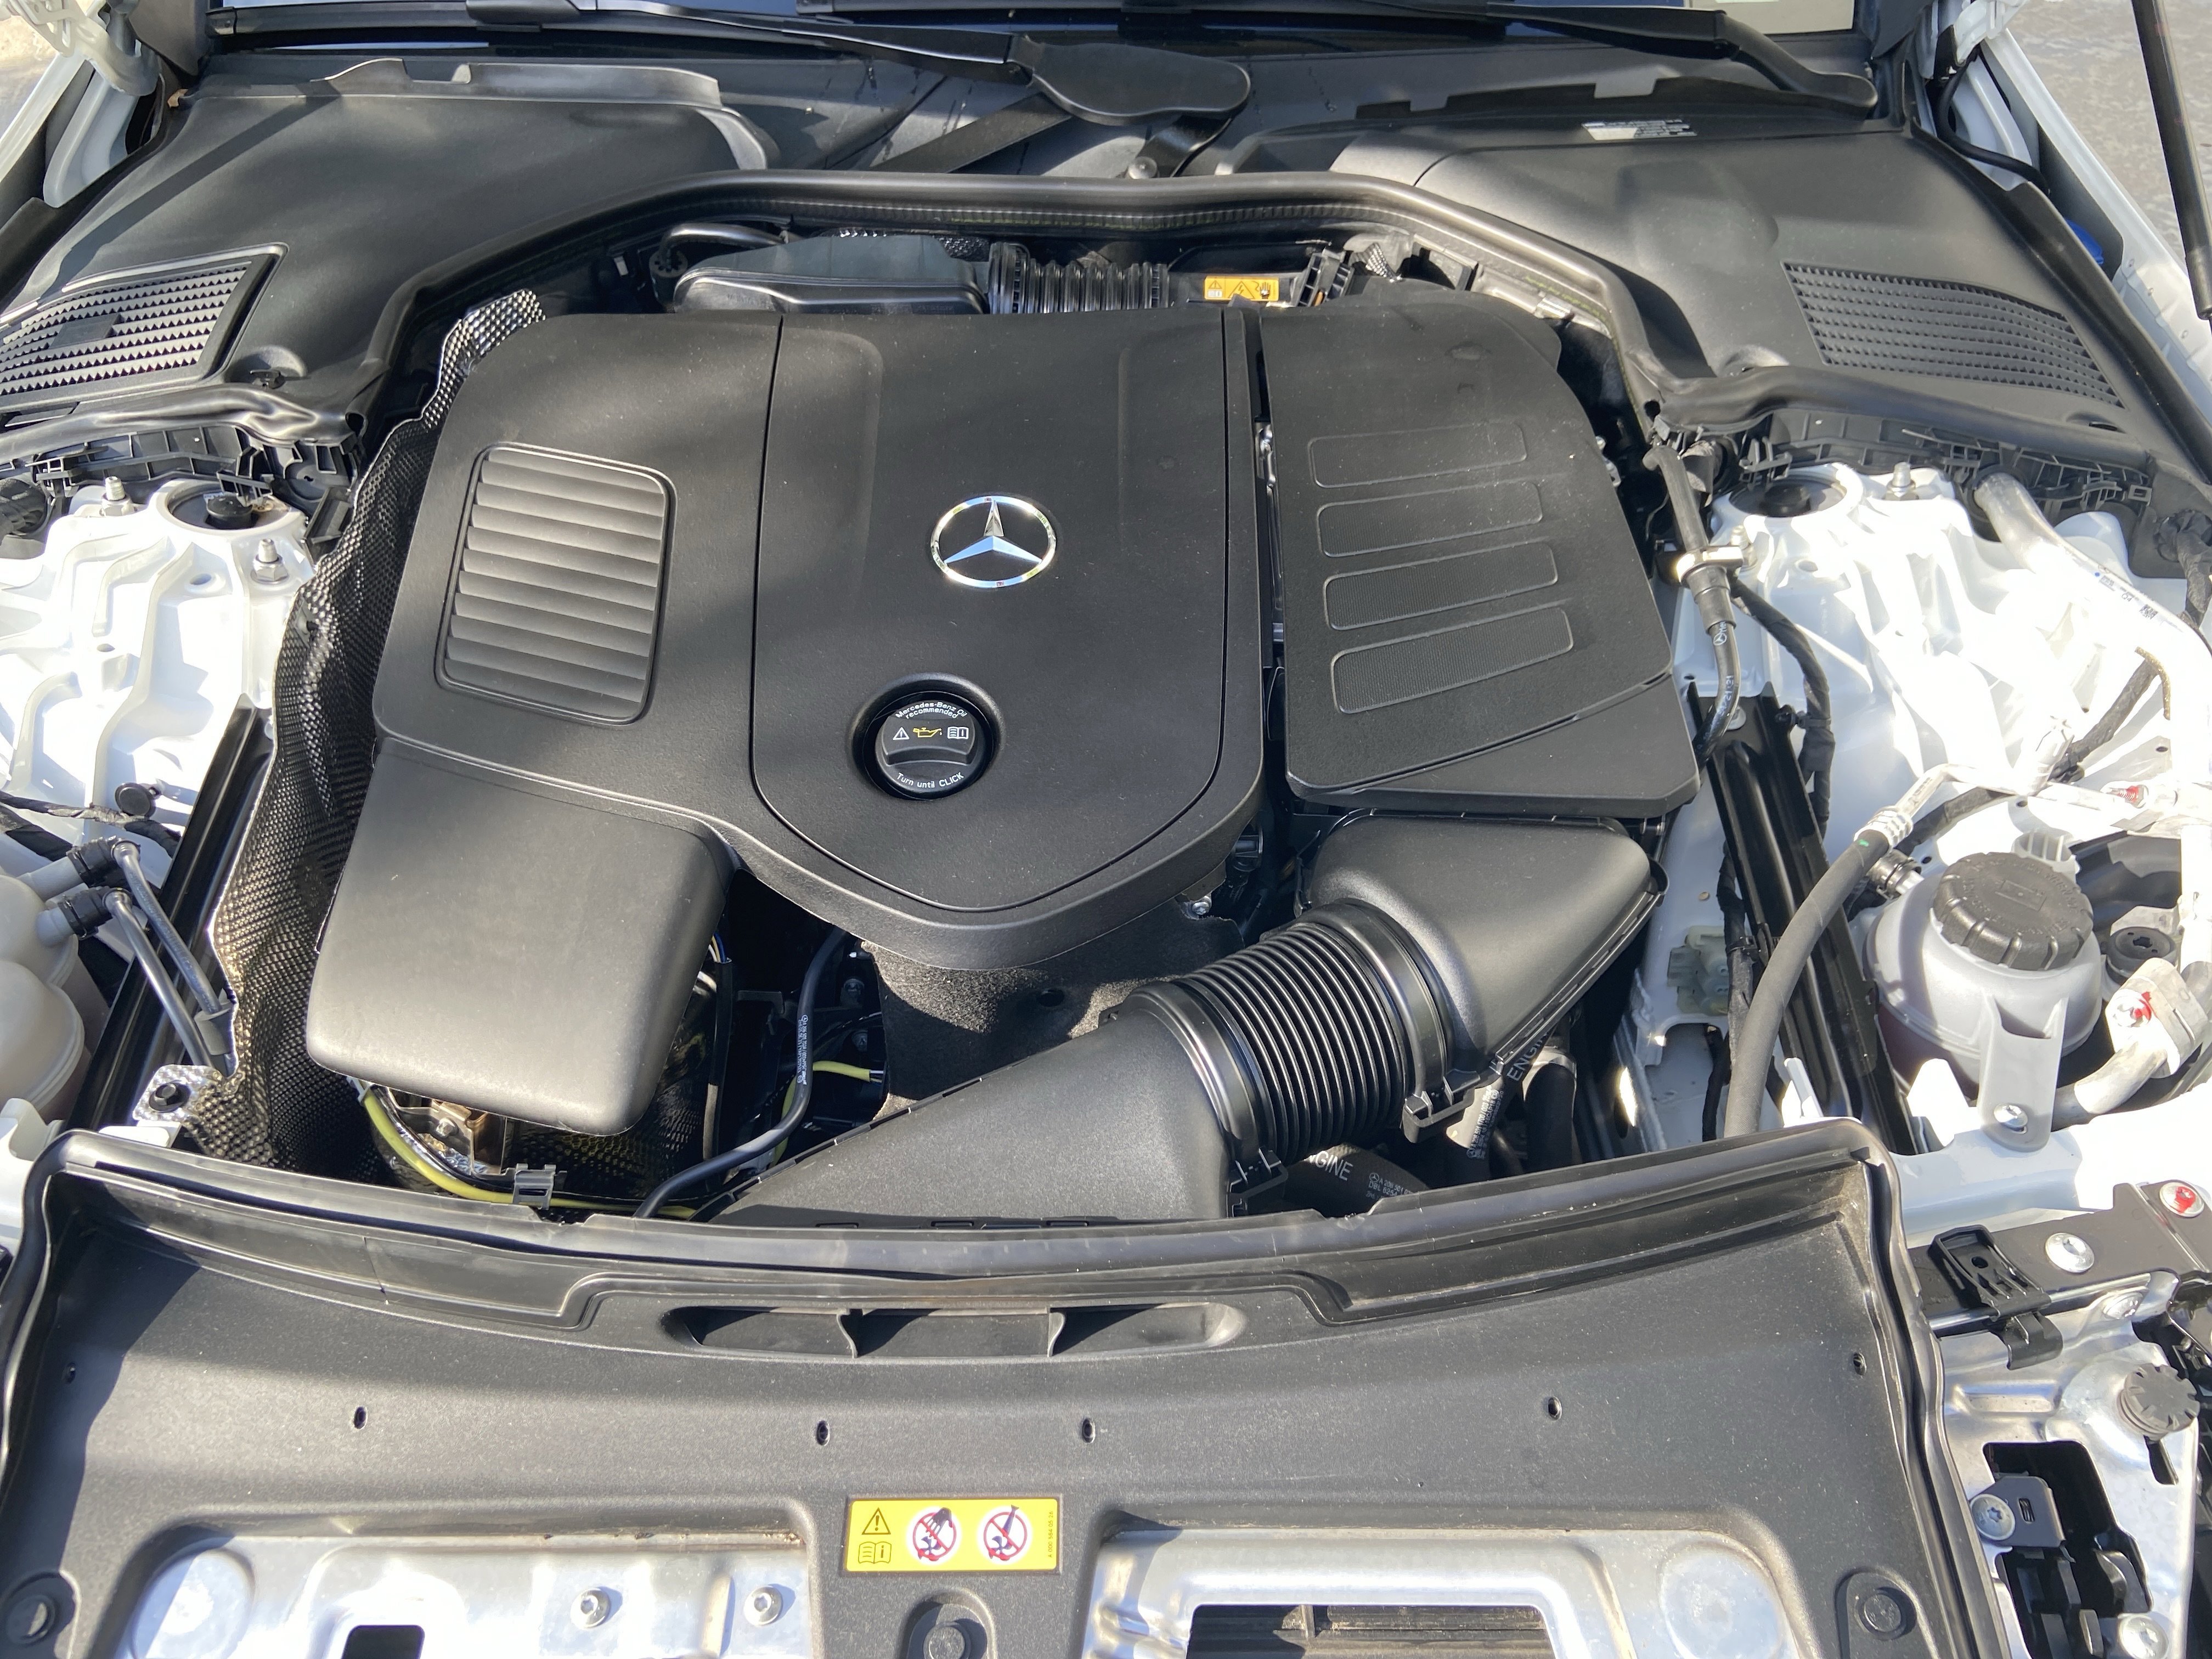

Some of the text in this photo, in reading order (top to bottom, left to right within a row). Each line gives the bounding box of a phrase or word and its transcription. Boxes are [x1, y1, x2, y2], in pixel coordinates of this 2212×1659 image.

[895, 702, 956, 718] Mercedes-Benz
[905, 708, 958, 719] recommended
[897, 772, 913, 786] Turn
[939, 772, 964, 787] CLICK
